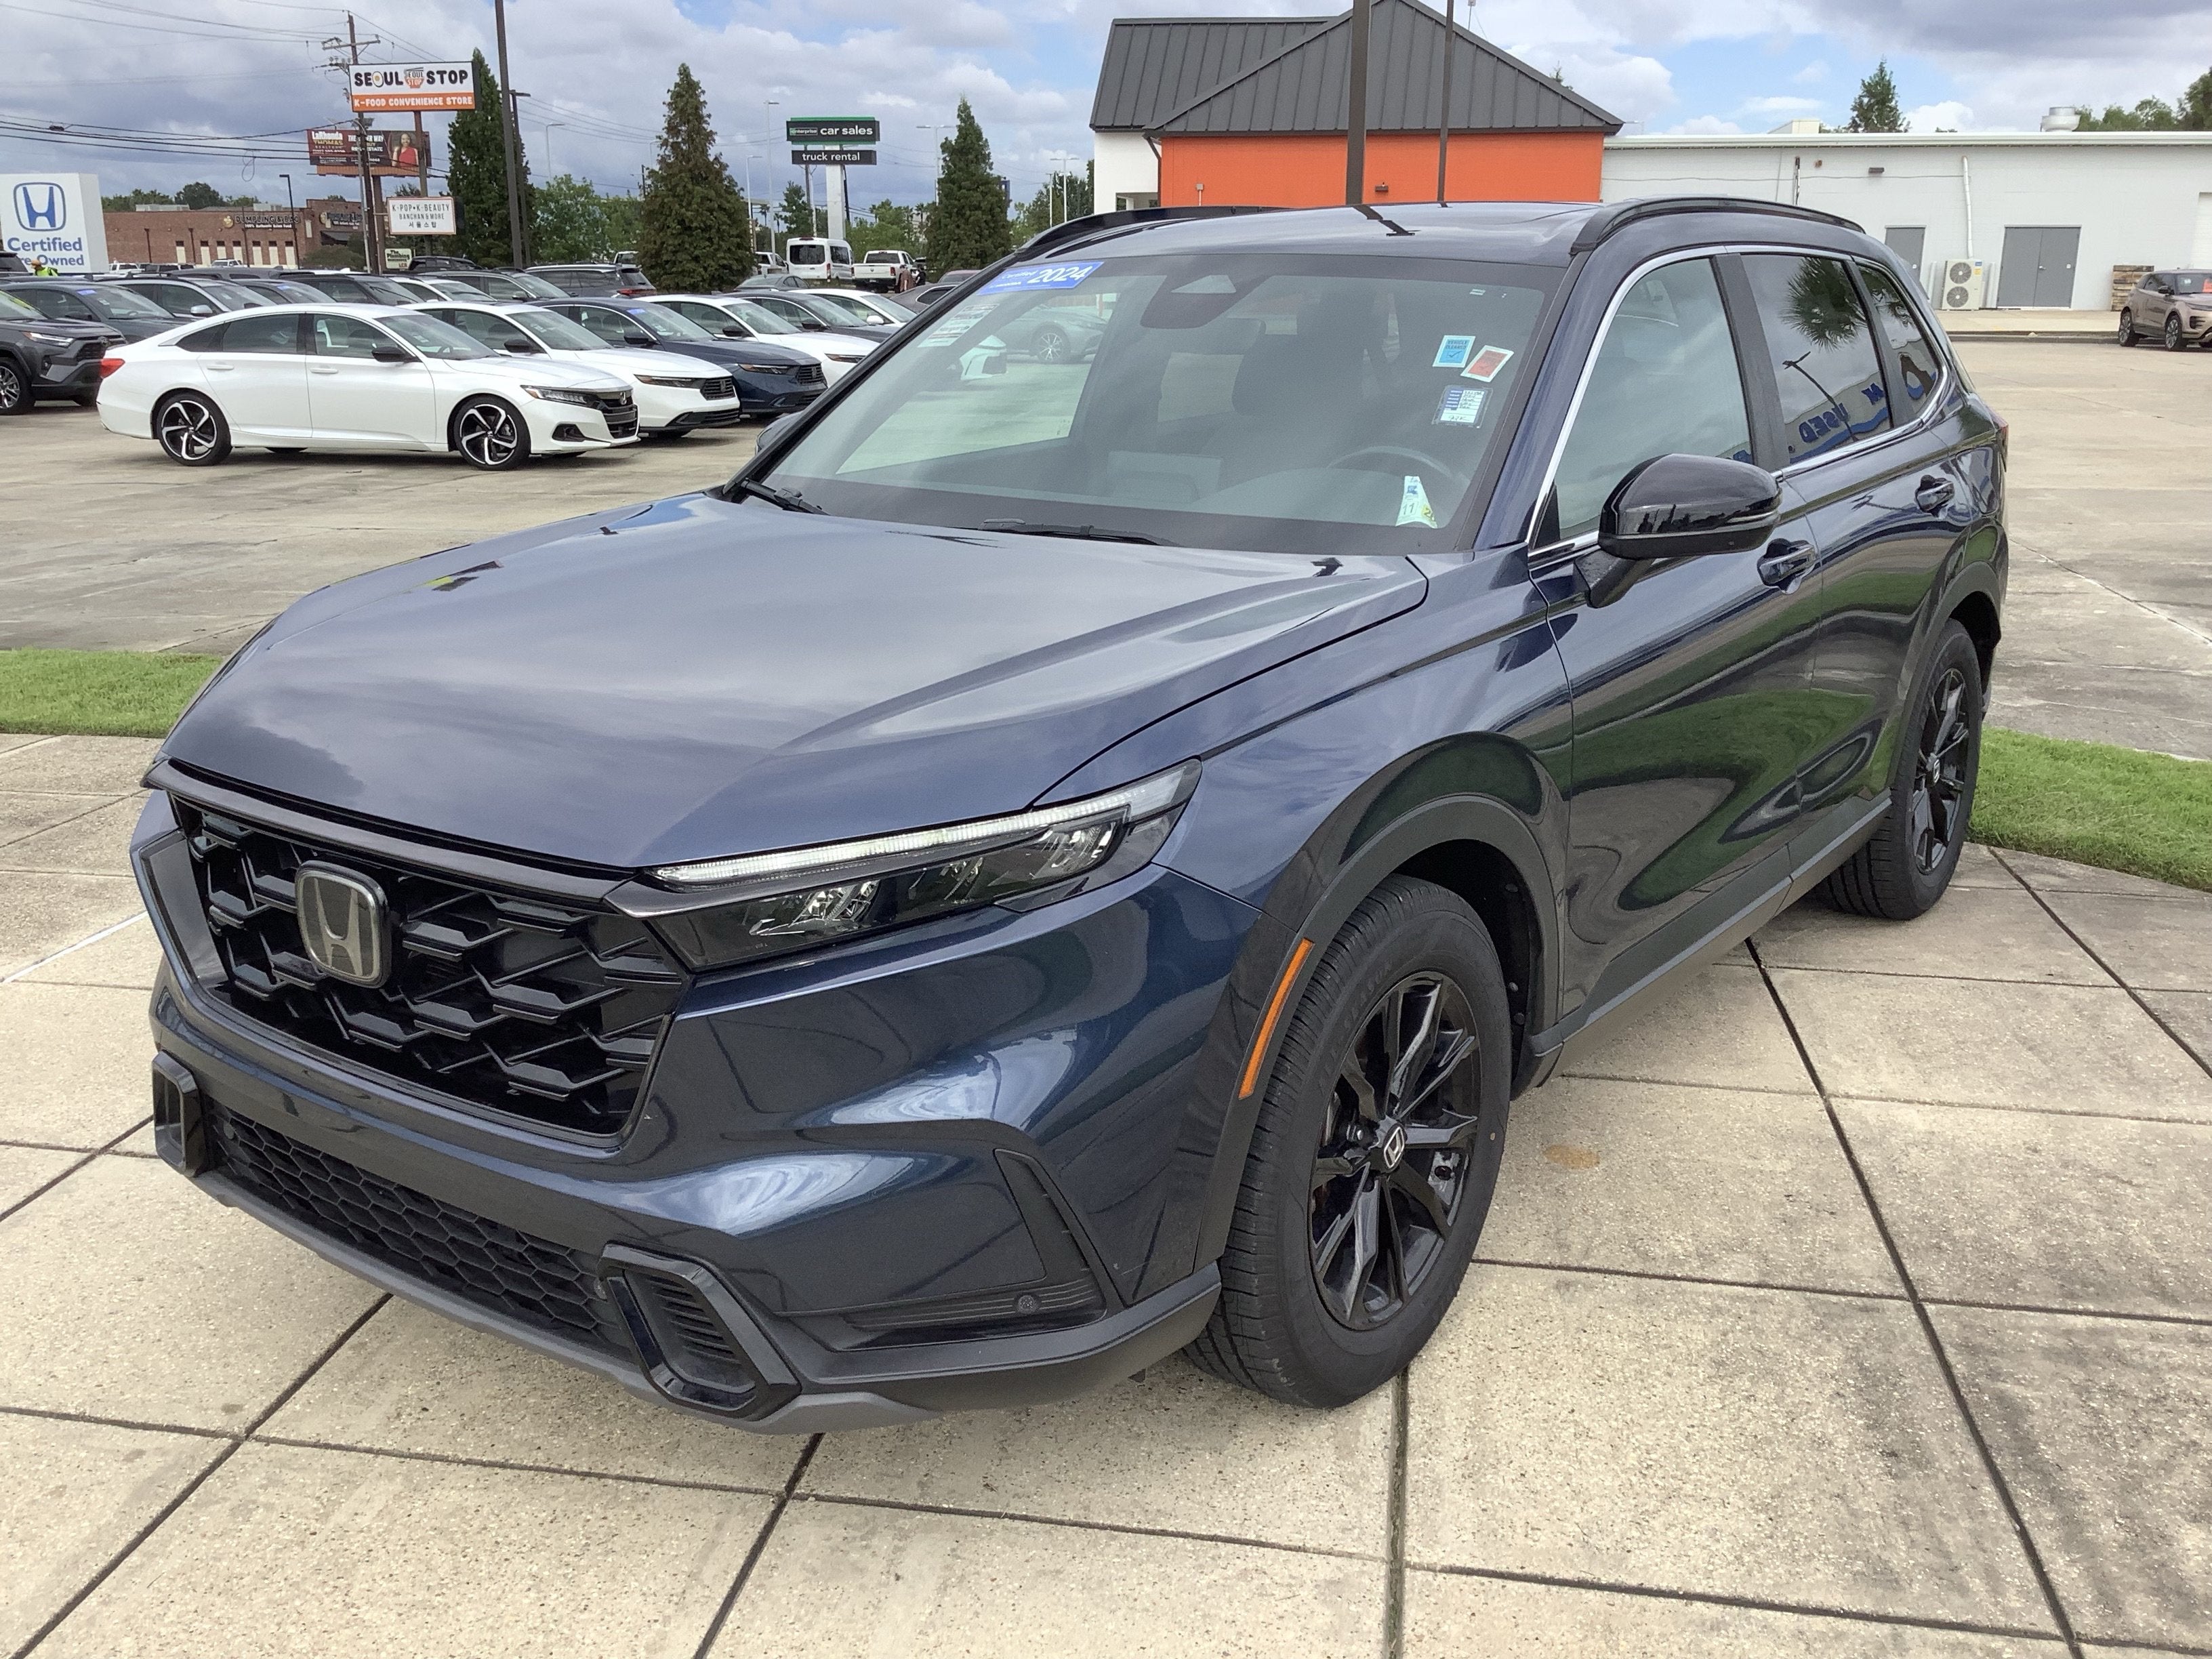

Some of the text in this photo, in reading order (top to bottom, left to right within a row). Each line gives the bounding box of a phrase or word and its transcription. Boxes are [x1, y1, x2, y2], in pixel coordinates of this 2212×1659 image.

[354, 69, 468, 87] SEOUL STOP
[354, 96, 472, 108] K-FOOD CONVENIENCE STORE
[820, 127, 840, 136] car
[842, 125, 873, 136] sales
[802, 152, 860, 161] truck rental
[7, 237, 83, 251] Certified
[37, 255, 85, 266] Owned
[1027, 266, 1092, 283] 2024
